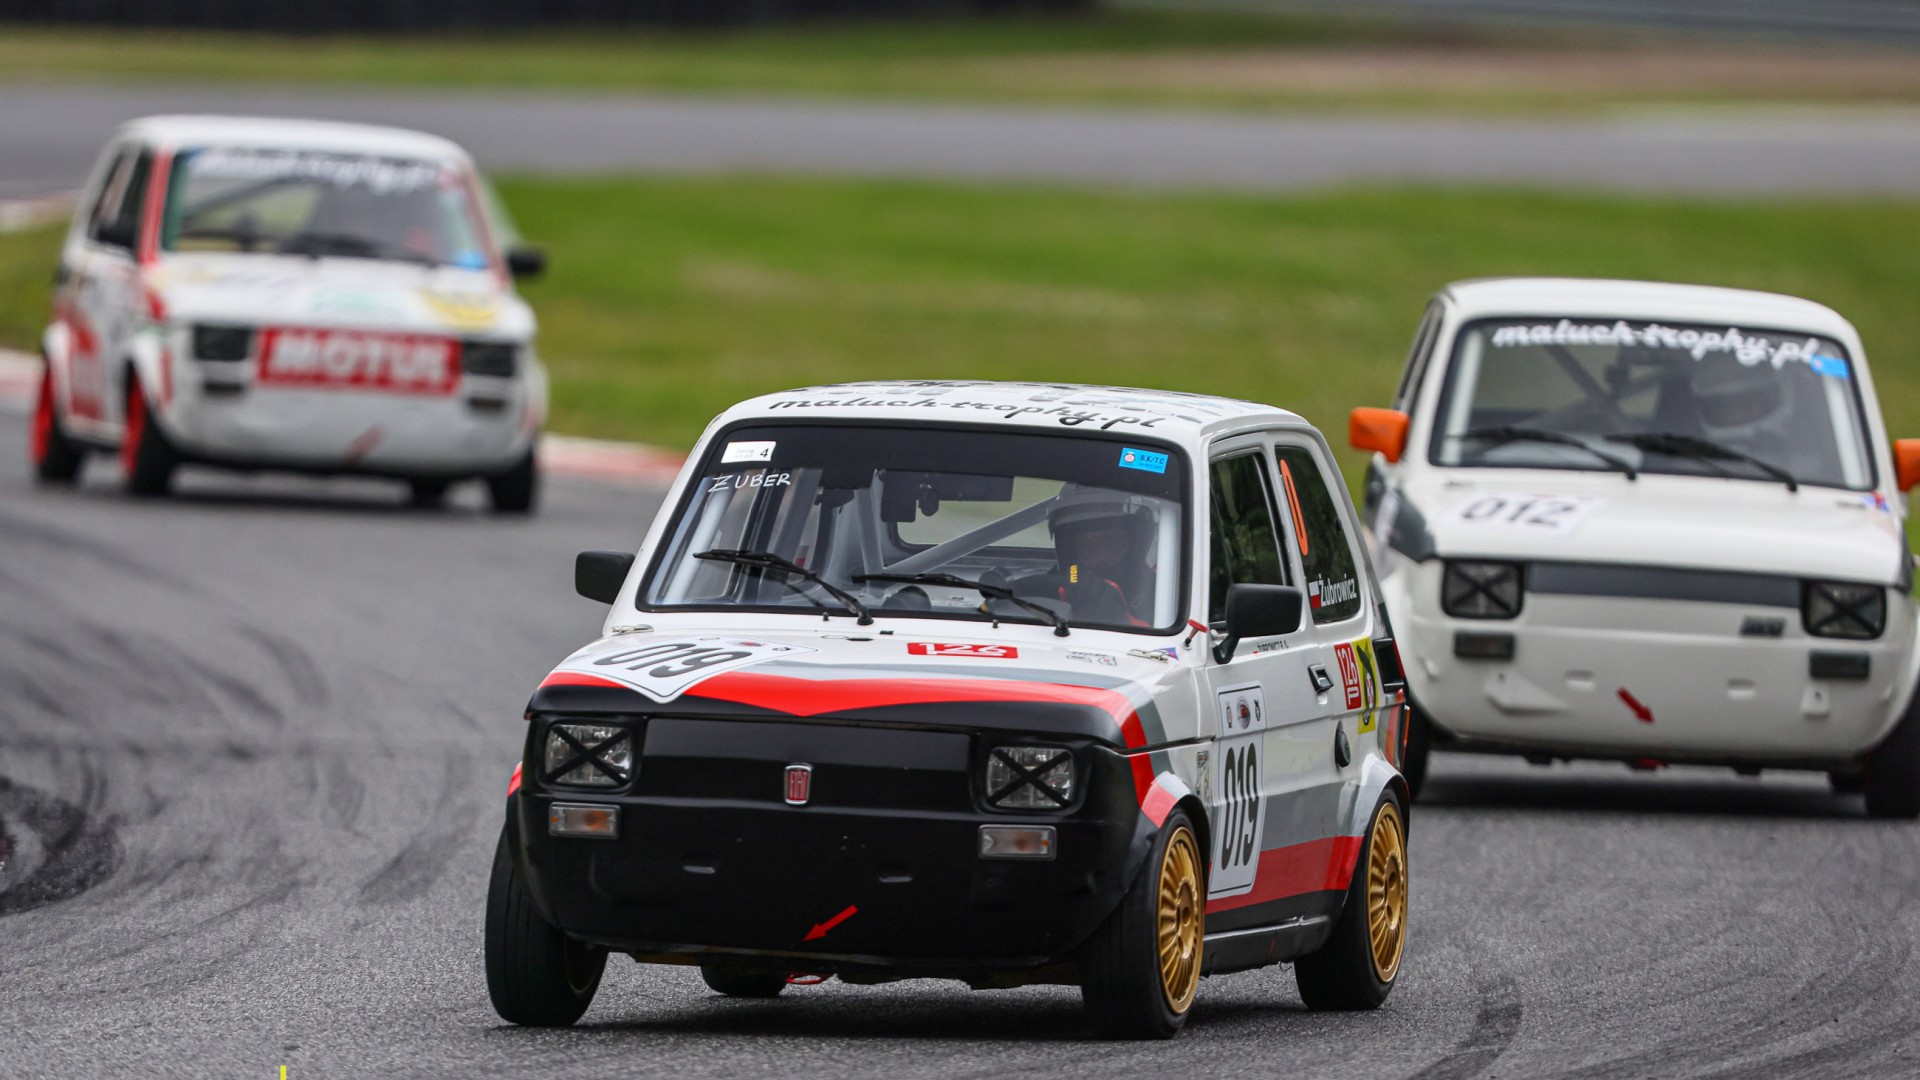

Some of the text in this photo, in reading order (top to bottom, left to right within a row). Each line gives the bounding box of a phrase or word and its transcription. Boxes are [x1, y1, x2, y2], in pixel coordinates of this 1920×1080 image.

[1492, 318, 1820, 370] maluch-trophy.pl
[769, 396, 1167, 430] maluch-trophy.pl
[760, 448, 769, 458] 4
[708, 473, 791, 493] ZUBER
[1461, 497, 1577, 527] 012
[1319, 574, 1357, 607] Żubrowicz
[593, 643, 752, 678] 019
[919, 643, 1007, 656] 126
[1338, 648, 1358, 685] 126
[1221, 742, 1260, 870] 019
